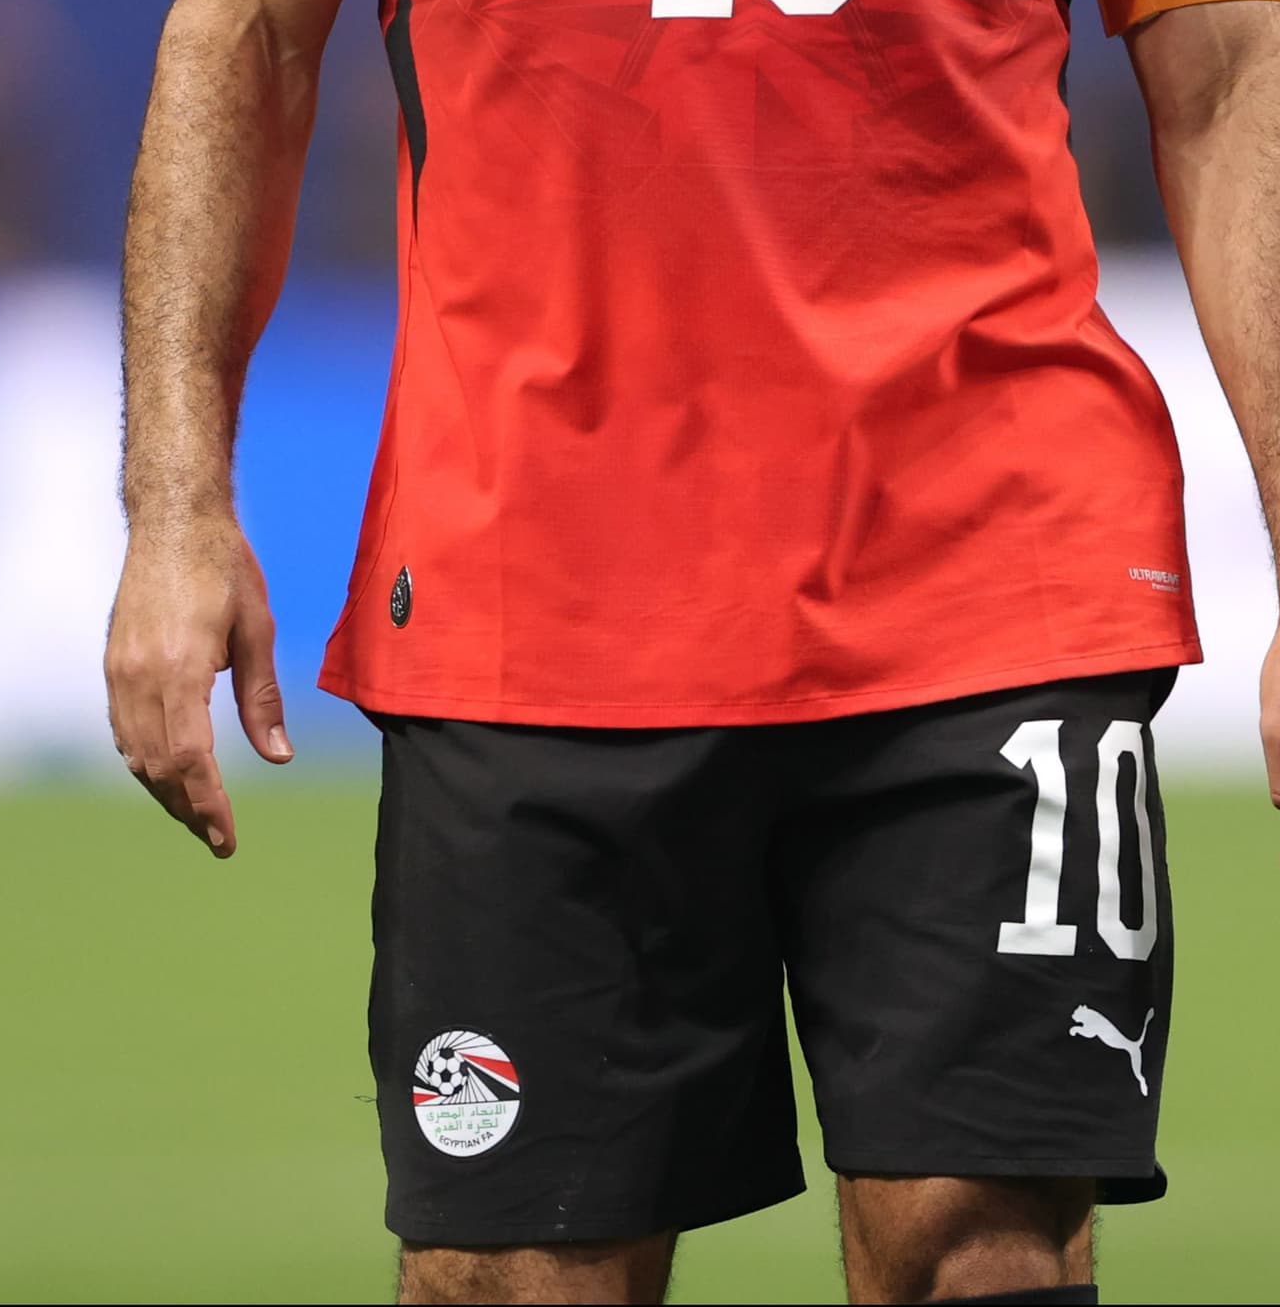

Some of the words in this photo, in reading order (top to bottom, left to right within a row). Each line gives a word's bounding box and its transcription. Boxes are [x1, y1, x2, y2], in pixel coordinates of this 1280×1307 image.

[996, 719, 1157, 961] 10
[439, 1134, 480, 1149] EGYPTIAN
[481, 1131, 494, 1141] FA
